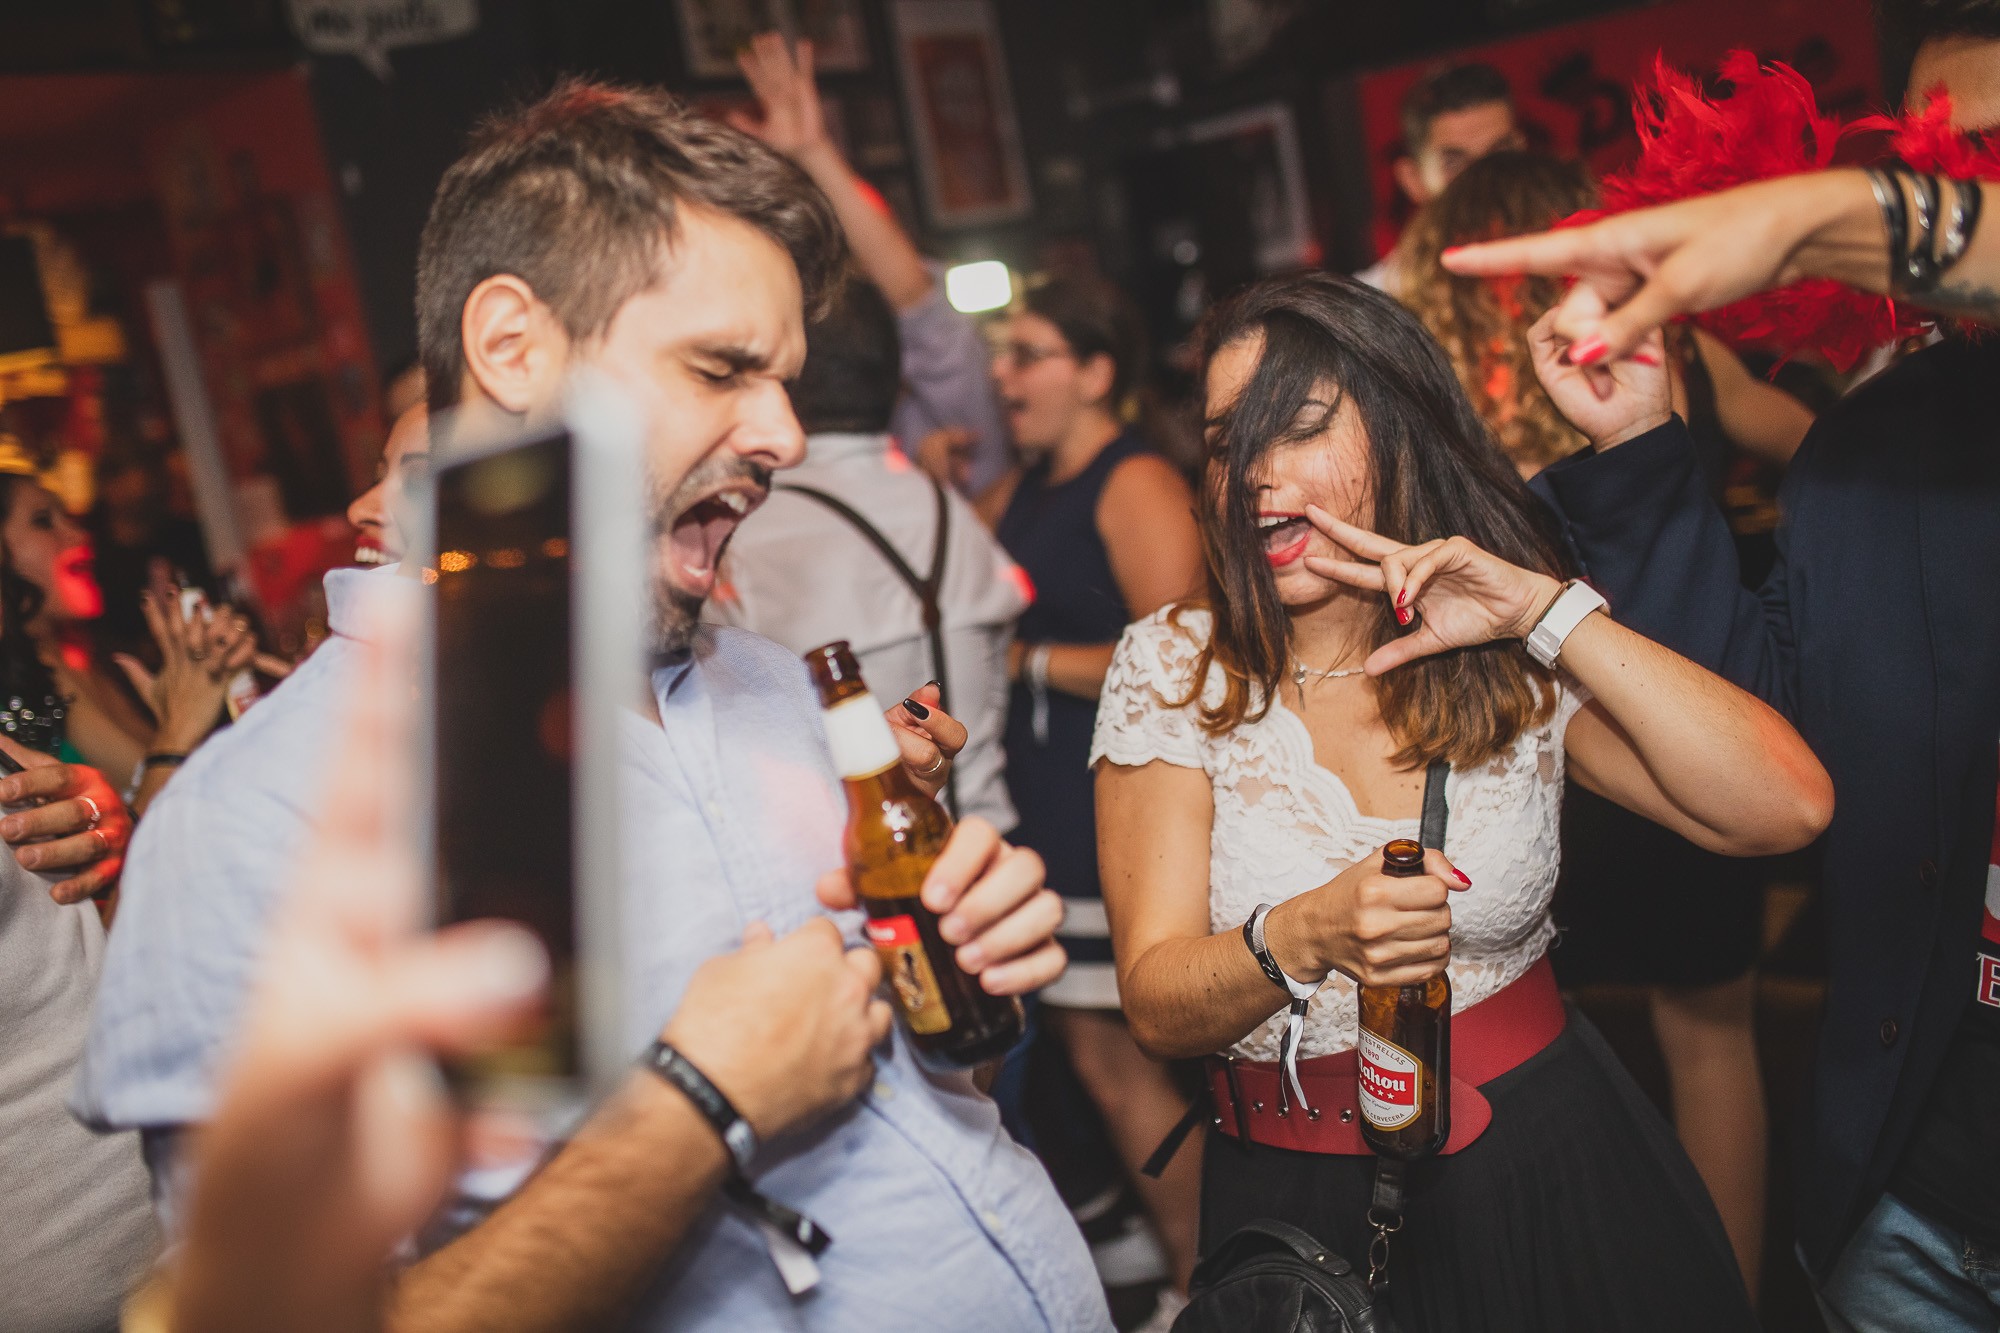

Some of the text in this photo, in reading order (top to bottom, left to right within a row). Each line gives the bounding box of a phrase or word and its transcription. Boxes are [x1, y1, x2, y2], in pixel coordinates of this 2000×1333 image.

[1364, 1036, 1406, 1066] ESTRELLAS
[1365, 1047, 1380, 1061] 1890
[1370, 1112, 1405, 1123] CERVECERA
